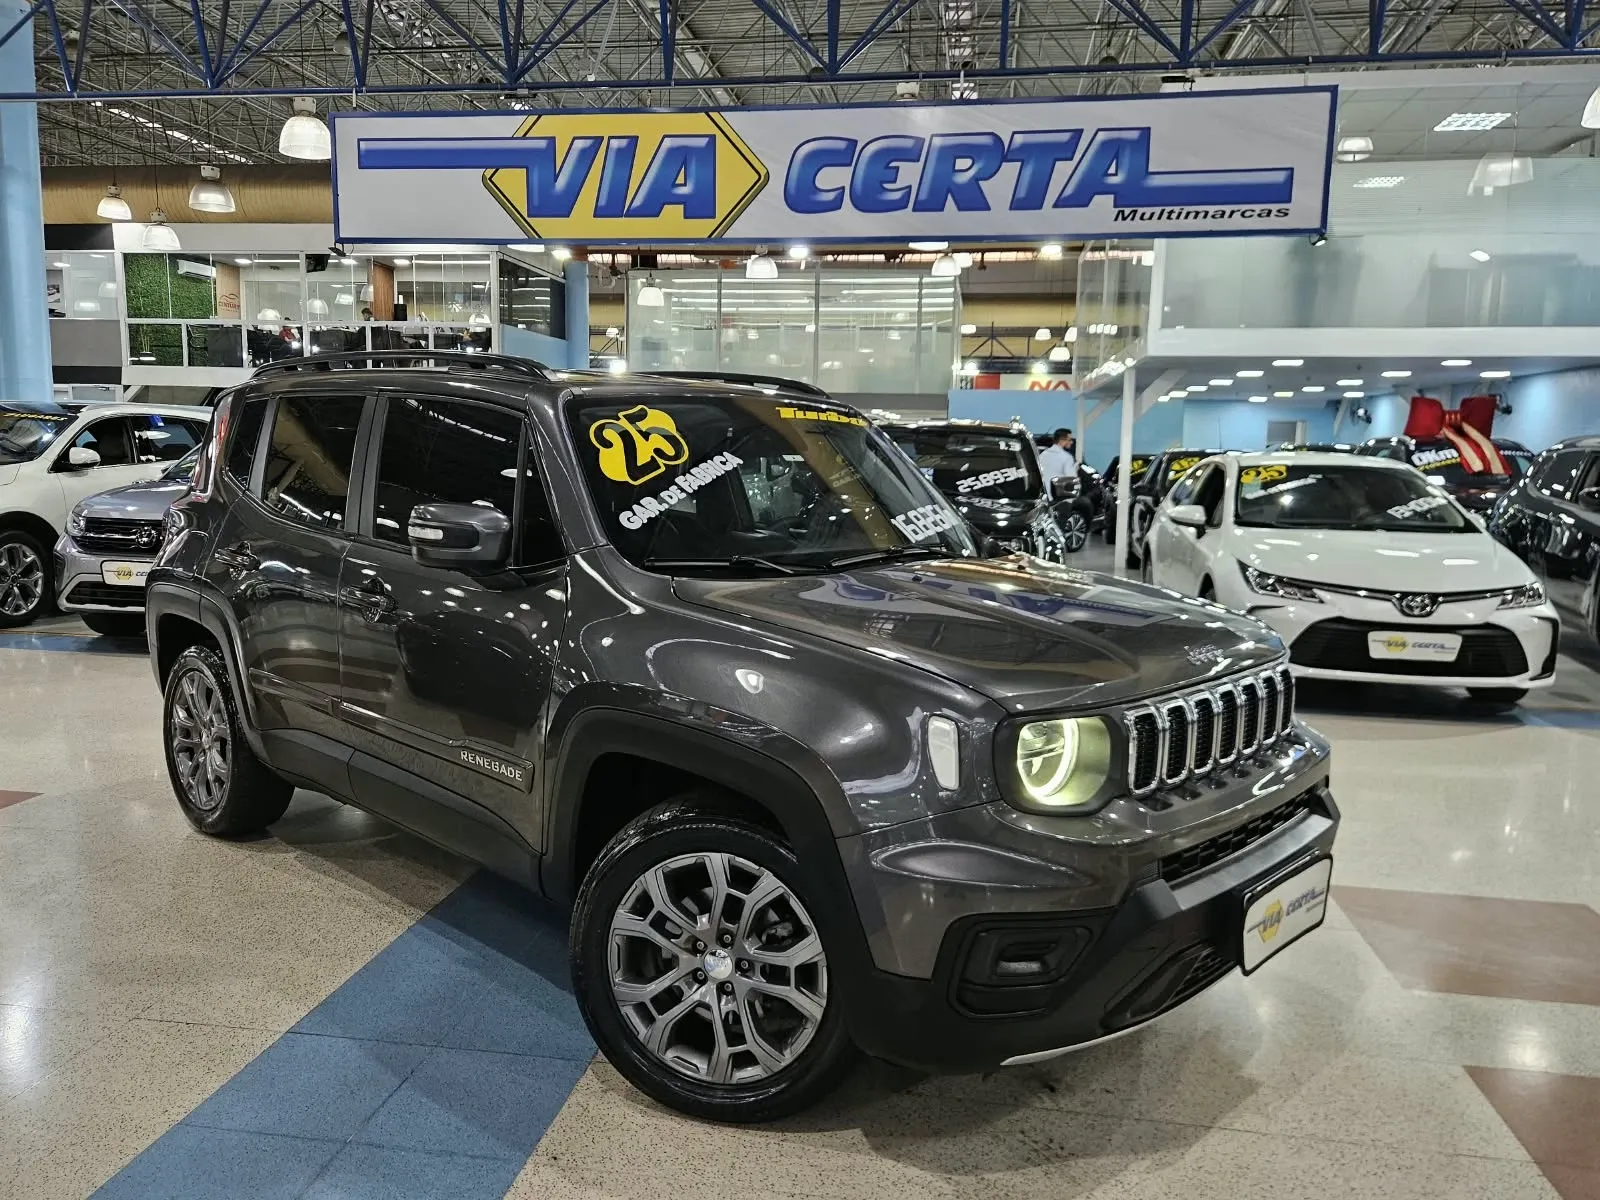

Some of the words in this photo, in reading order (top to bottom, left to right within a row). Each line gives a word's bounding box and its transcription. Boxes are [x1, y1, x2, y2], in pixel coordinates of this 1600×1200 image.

[525, 134, 718, 220] VIA
[783, 127, 1152, 214] CERTA
[1113, 205, 1292, 222] Multimarcas
[775, 407, 868, 427] Turbo
[590, 404, 689, 486] 25
[618, 496, 669, 530] GAR.
[659, 485, 687, 506] DE
[674, 451, 744, 494] FABRICA
[460, 750, 522, 781] RENEGADE
